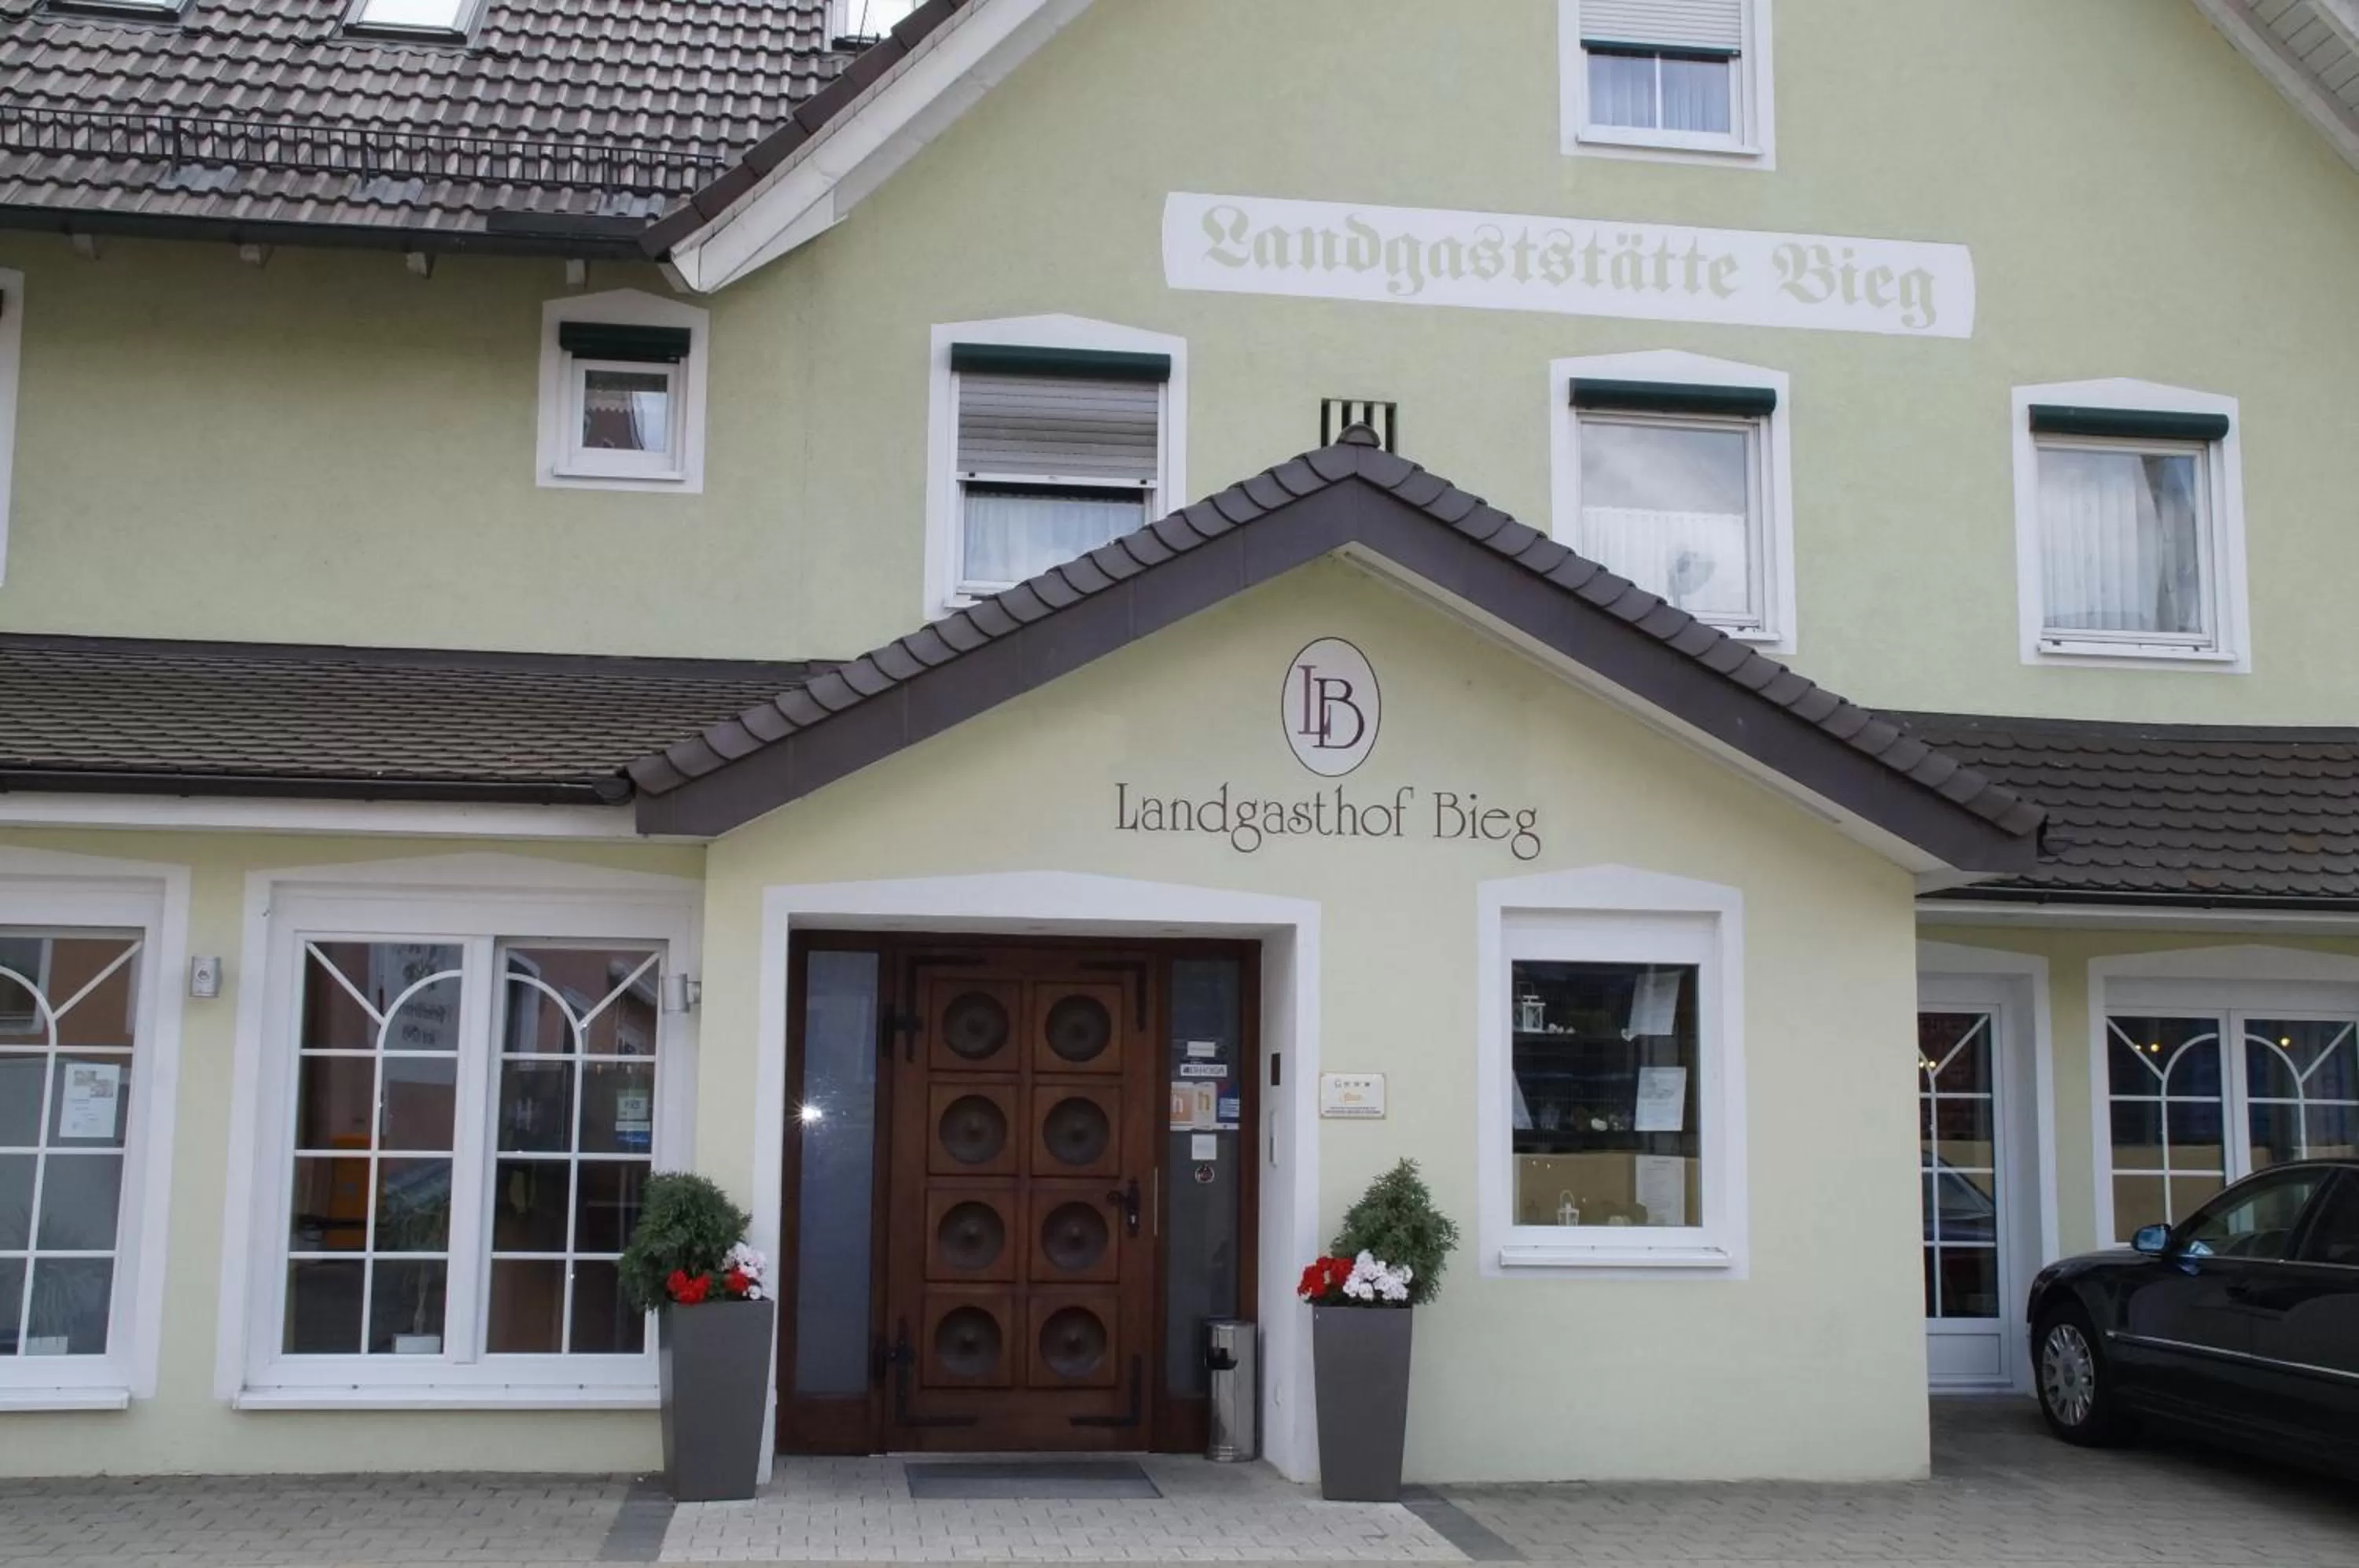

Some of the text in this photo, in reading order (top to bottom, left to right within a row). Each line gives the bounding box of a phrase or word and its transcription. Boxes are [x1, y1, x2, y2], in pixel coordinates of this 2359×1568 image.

[1201, 203, 1937, 329] Landgaststätte Bieg
[1115, 782, 1541, 860] Landgasthof Bieg
